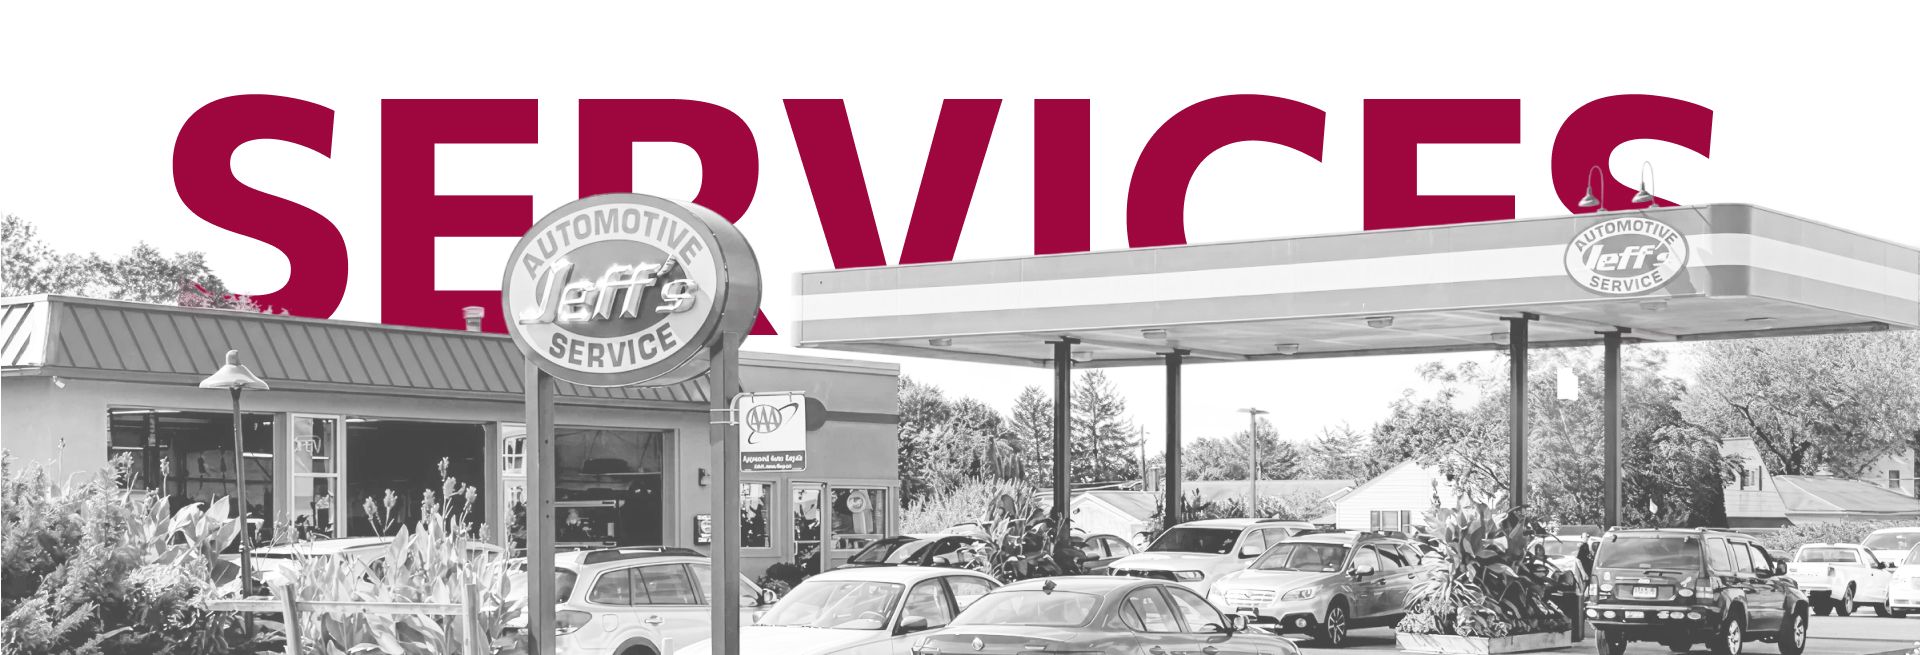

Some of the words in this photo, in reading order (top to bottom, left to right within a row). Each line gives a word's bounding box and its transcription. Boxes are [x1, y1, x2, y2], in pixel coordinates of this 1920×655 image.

[522, 207, 704, 281] AUTOMOTIVE
[1574, 219, 1678, 252] AUTOMOTIVE
[518, 253, 699, 325] Jeff's
[1589, 270, 1663, 292] SERVICE
[549, 322, 678, 369] SERVICE
[750, 405, 781, 433] AAA
